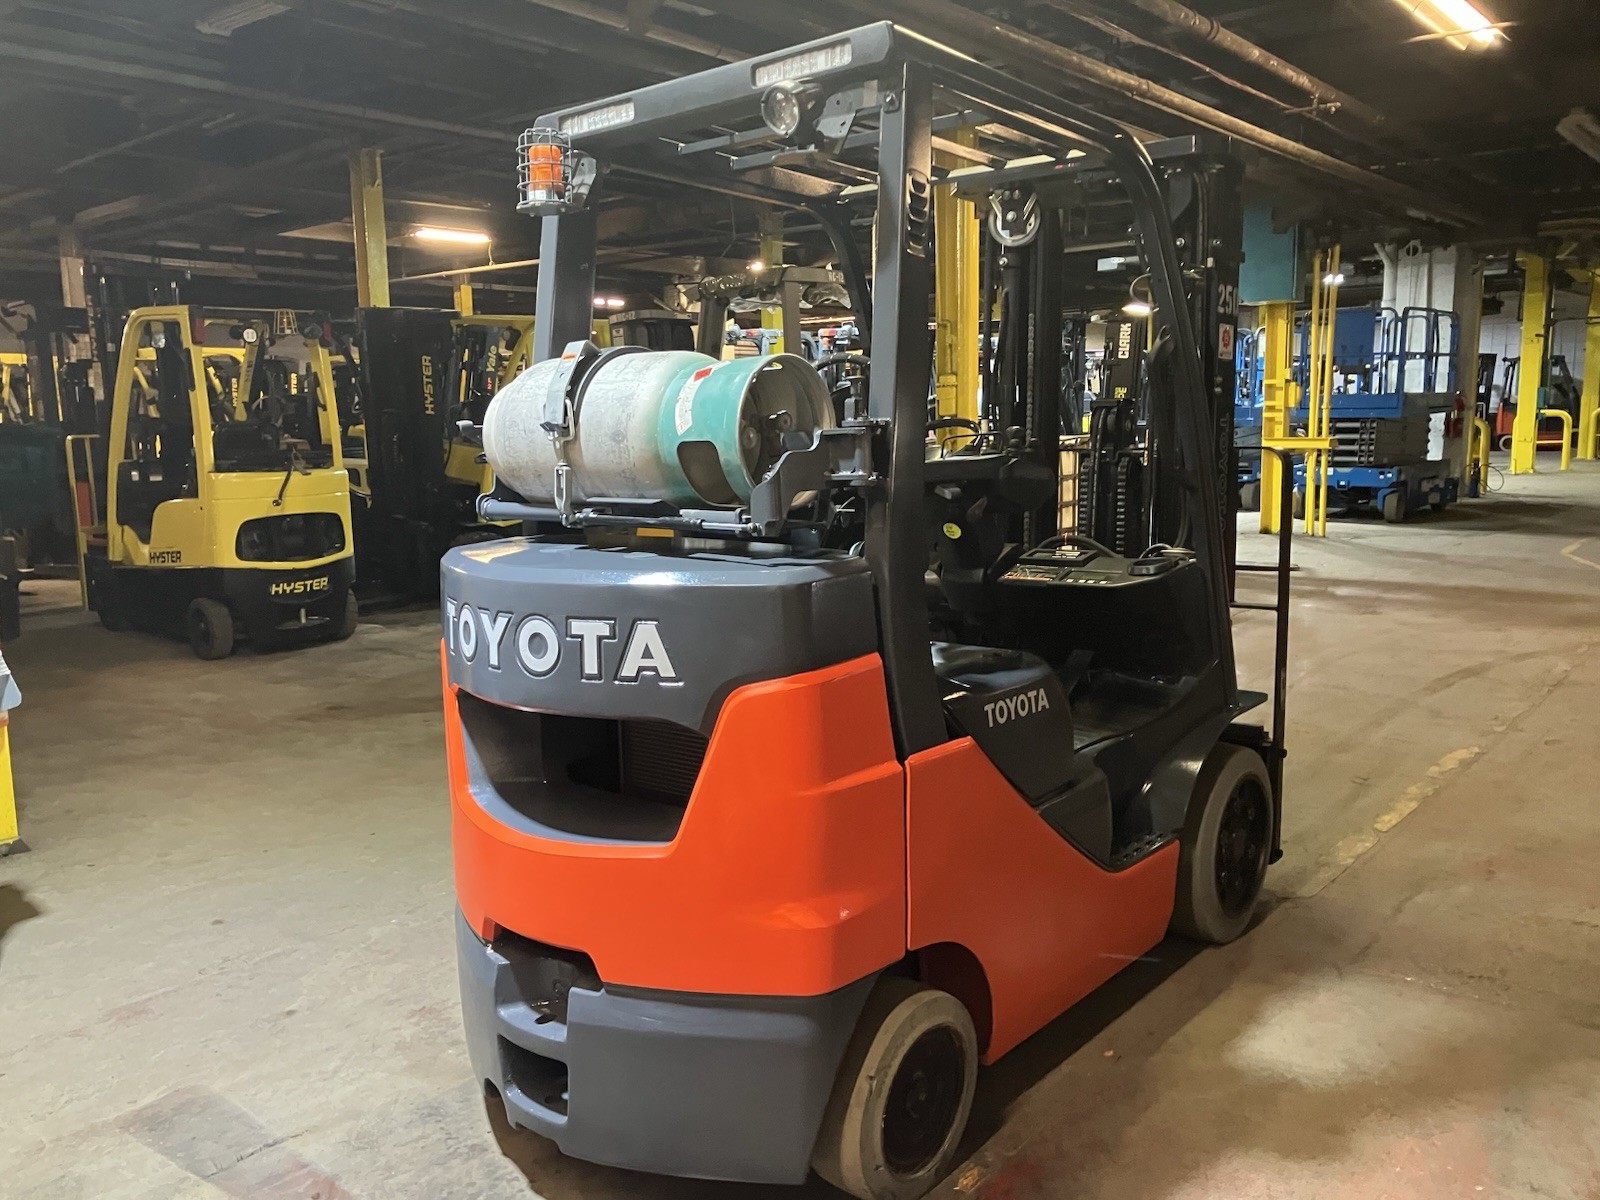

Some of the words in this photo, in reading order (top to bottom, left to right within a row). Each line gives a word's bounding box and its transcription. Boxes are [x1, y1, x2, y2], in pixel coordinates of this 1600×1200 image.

[1118, 323, 1132, 359] CLARK
[485, 345, 498, 372] Yale
[290, 372, 298, 396] STER
[422, 355, 435, 415] HYSTER
[148, 550, 182, 564] HYSTER
[272, 577, 329, 595] HYSTER
[446, 599, 680, 683] TOYOTA
[983, 687, 1049, 728] TOYOTA
